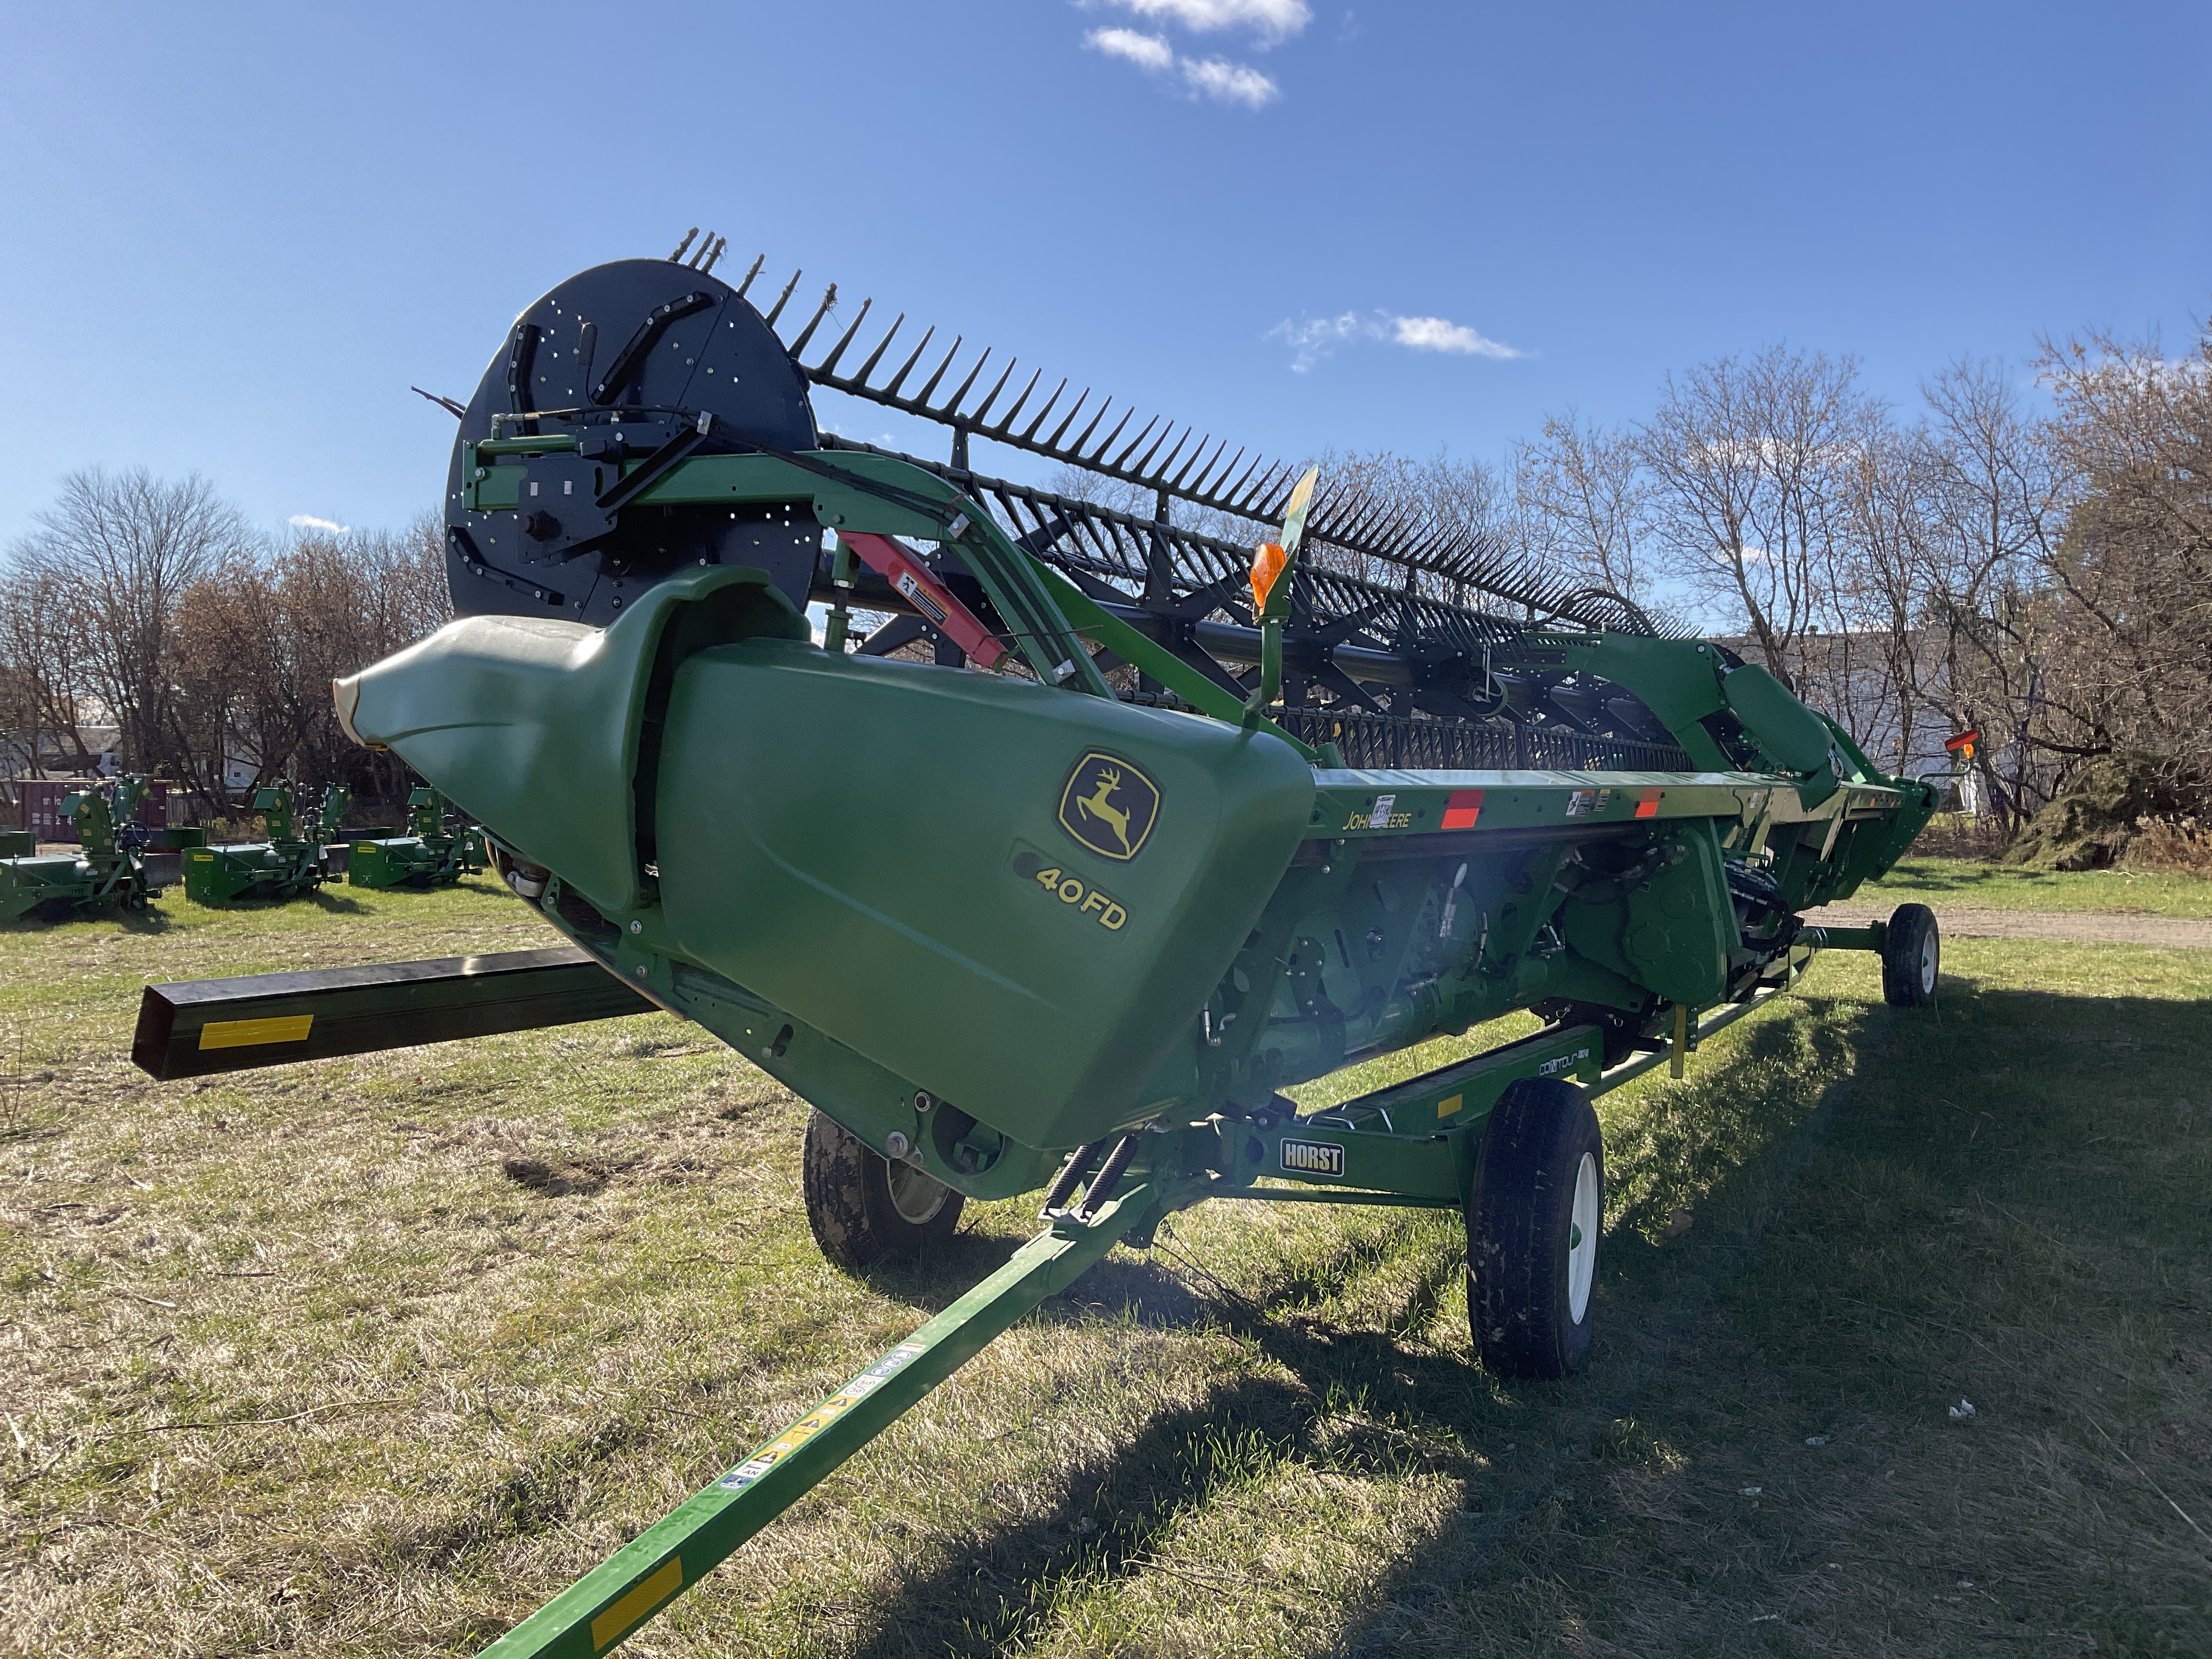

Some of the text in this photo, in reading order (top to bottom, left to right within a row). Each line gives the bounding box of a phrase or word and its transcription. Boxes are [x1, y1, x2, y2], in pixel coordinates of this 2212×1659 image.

[1374, 812, 1412, 829] EERE
[1036, 868, 1127, 930] 40FD
[1285, 1143, 1340, 1171] HORST
